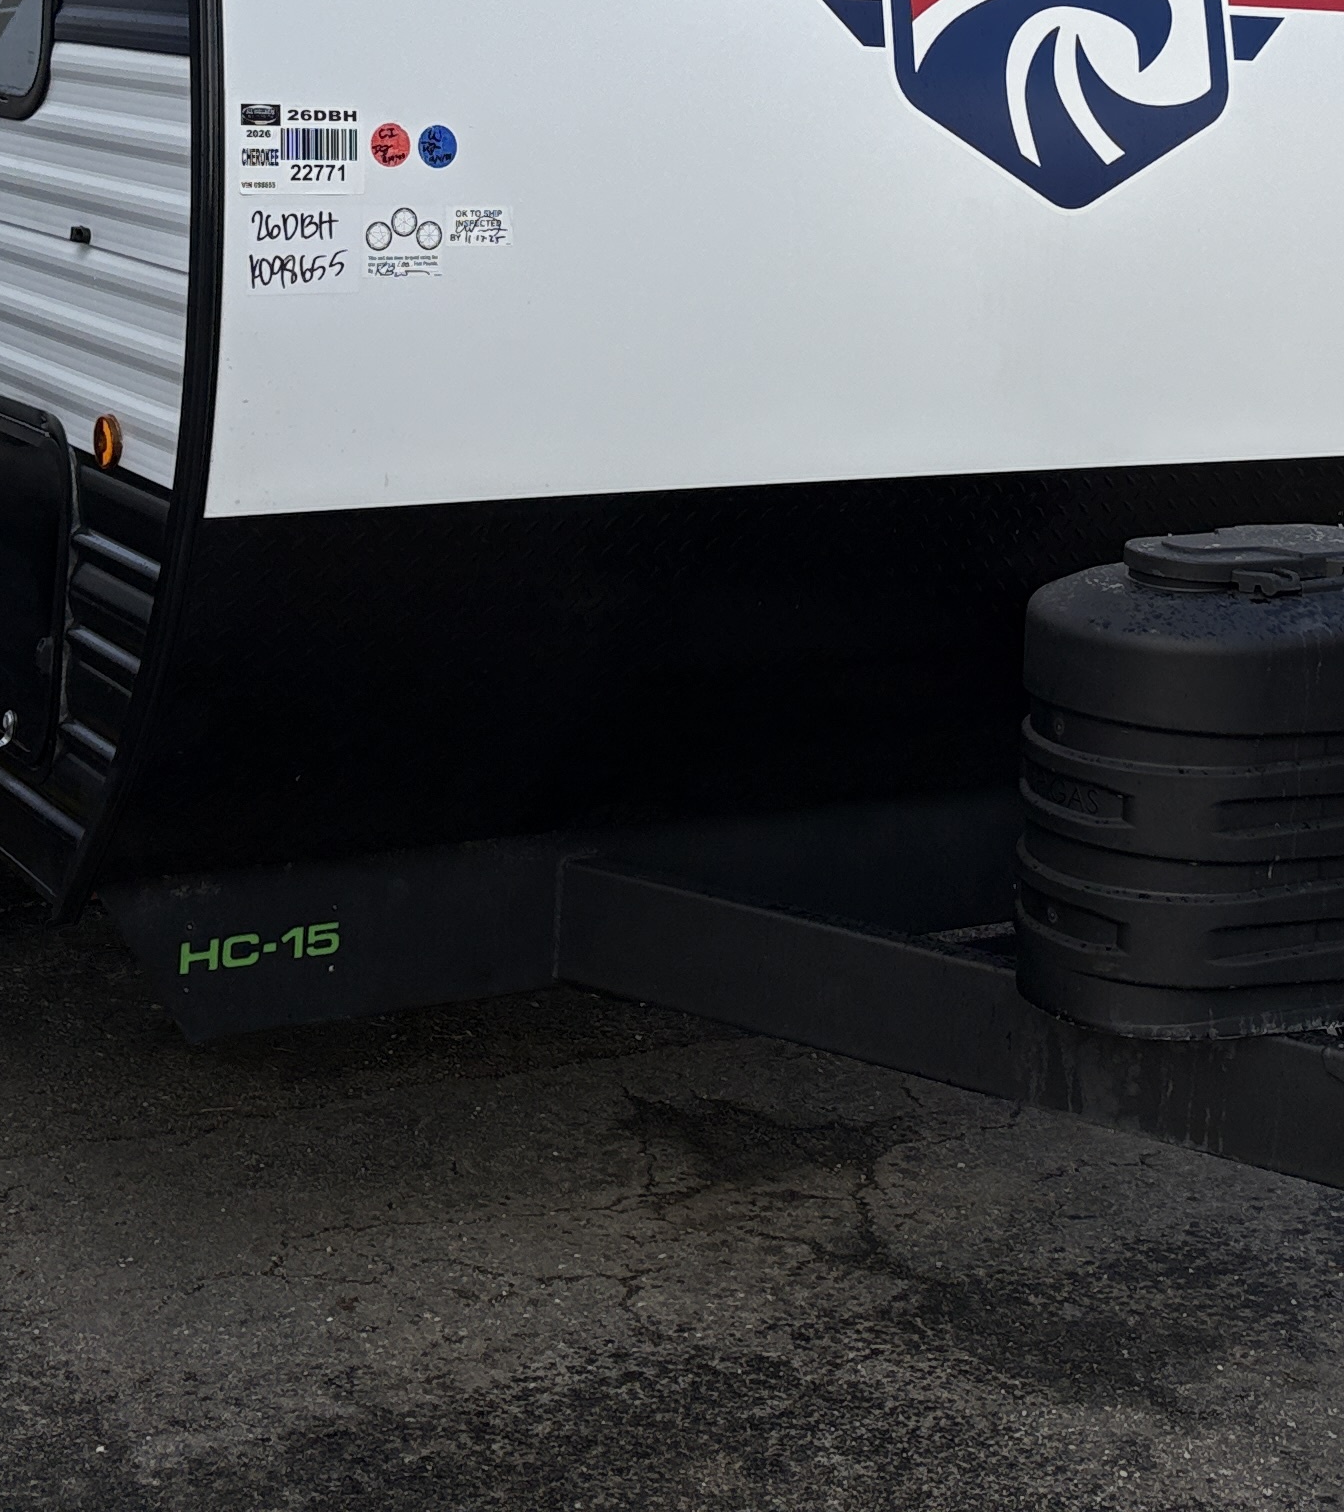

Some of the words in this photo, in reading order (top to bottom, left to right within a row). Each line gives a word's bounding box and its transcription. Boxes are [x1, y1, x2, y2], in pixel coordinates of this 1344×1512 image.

[287, 109, 357, 122] 26DBH
[246, 129, 272, 138] 2026
[241, 148, 280, 166] CHEROKEE
[290, 164, 345, 181] 22771
[455, 209, 469, 218] OK
[470, 209, 481, 218] TO
[483, 209, 503, 218] SHIP
[251, 210, 340, 241] 26DBH
[449, 233, 461, 242] BY
[179, 922, 340, 975] HC-15
